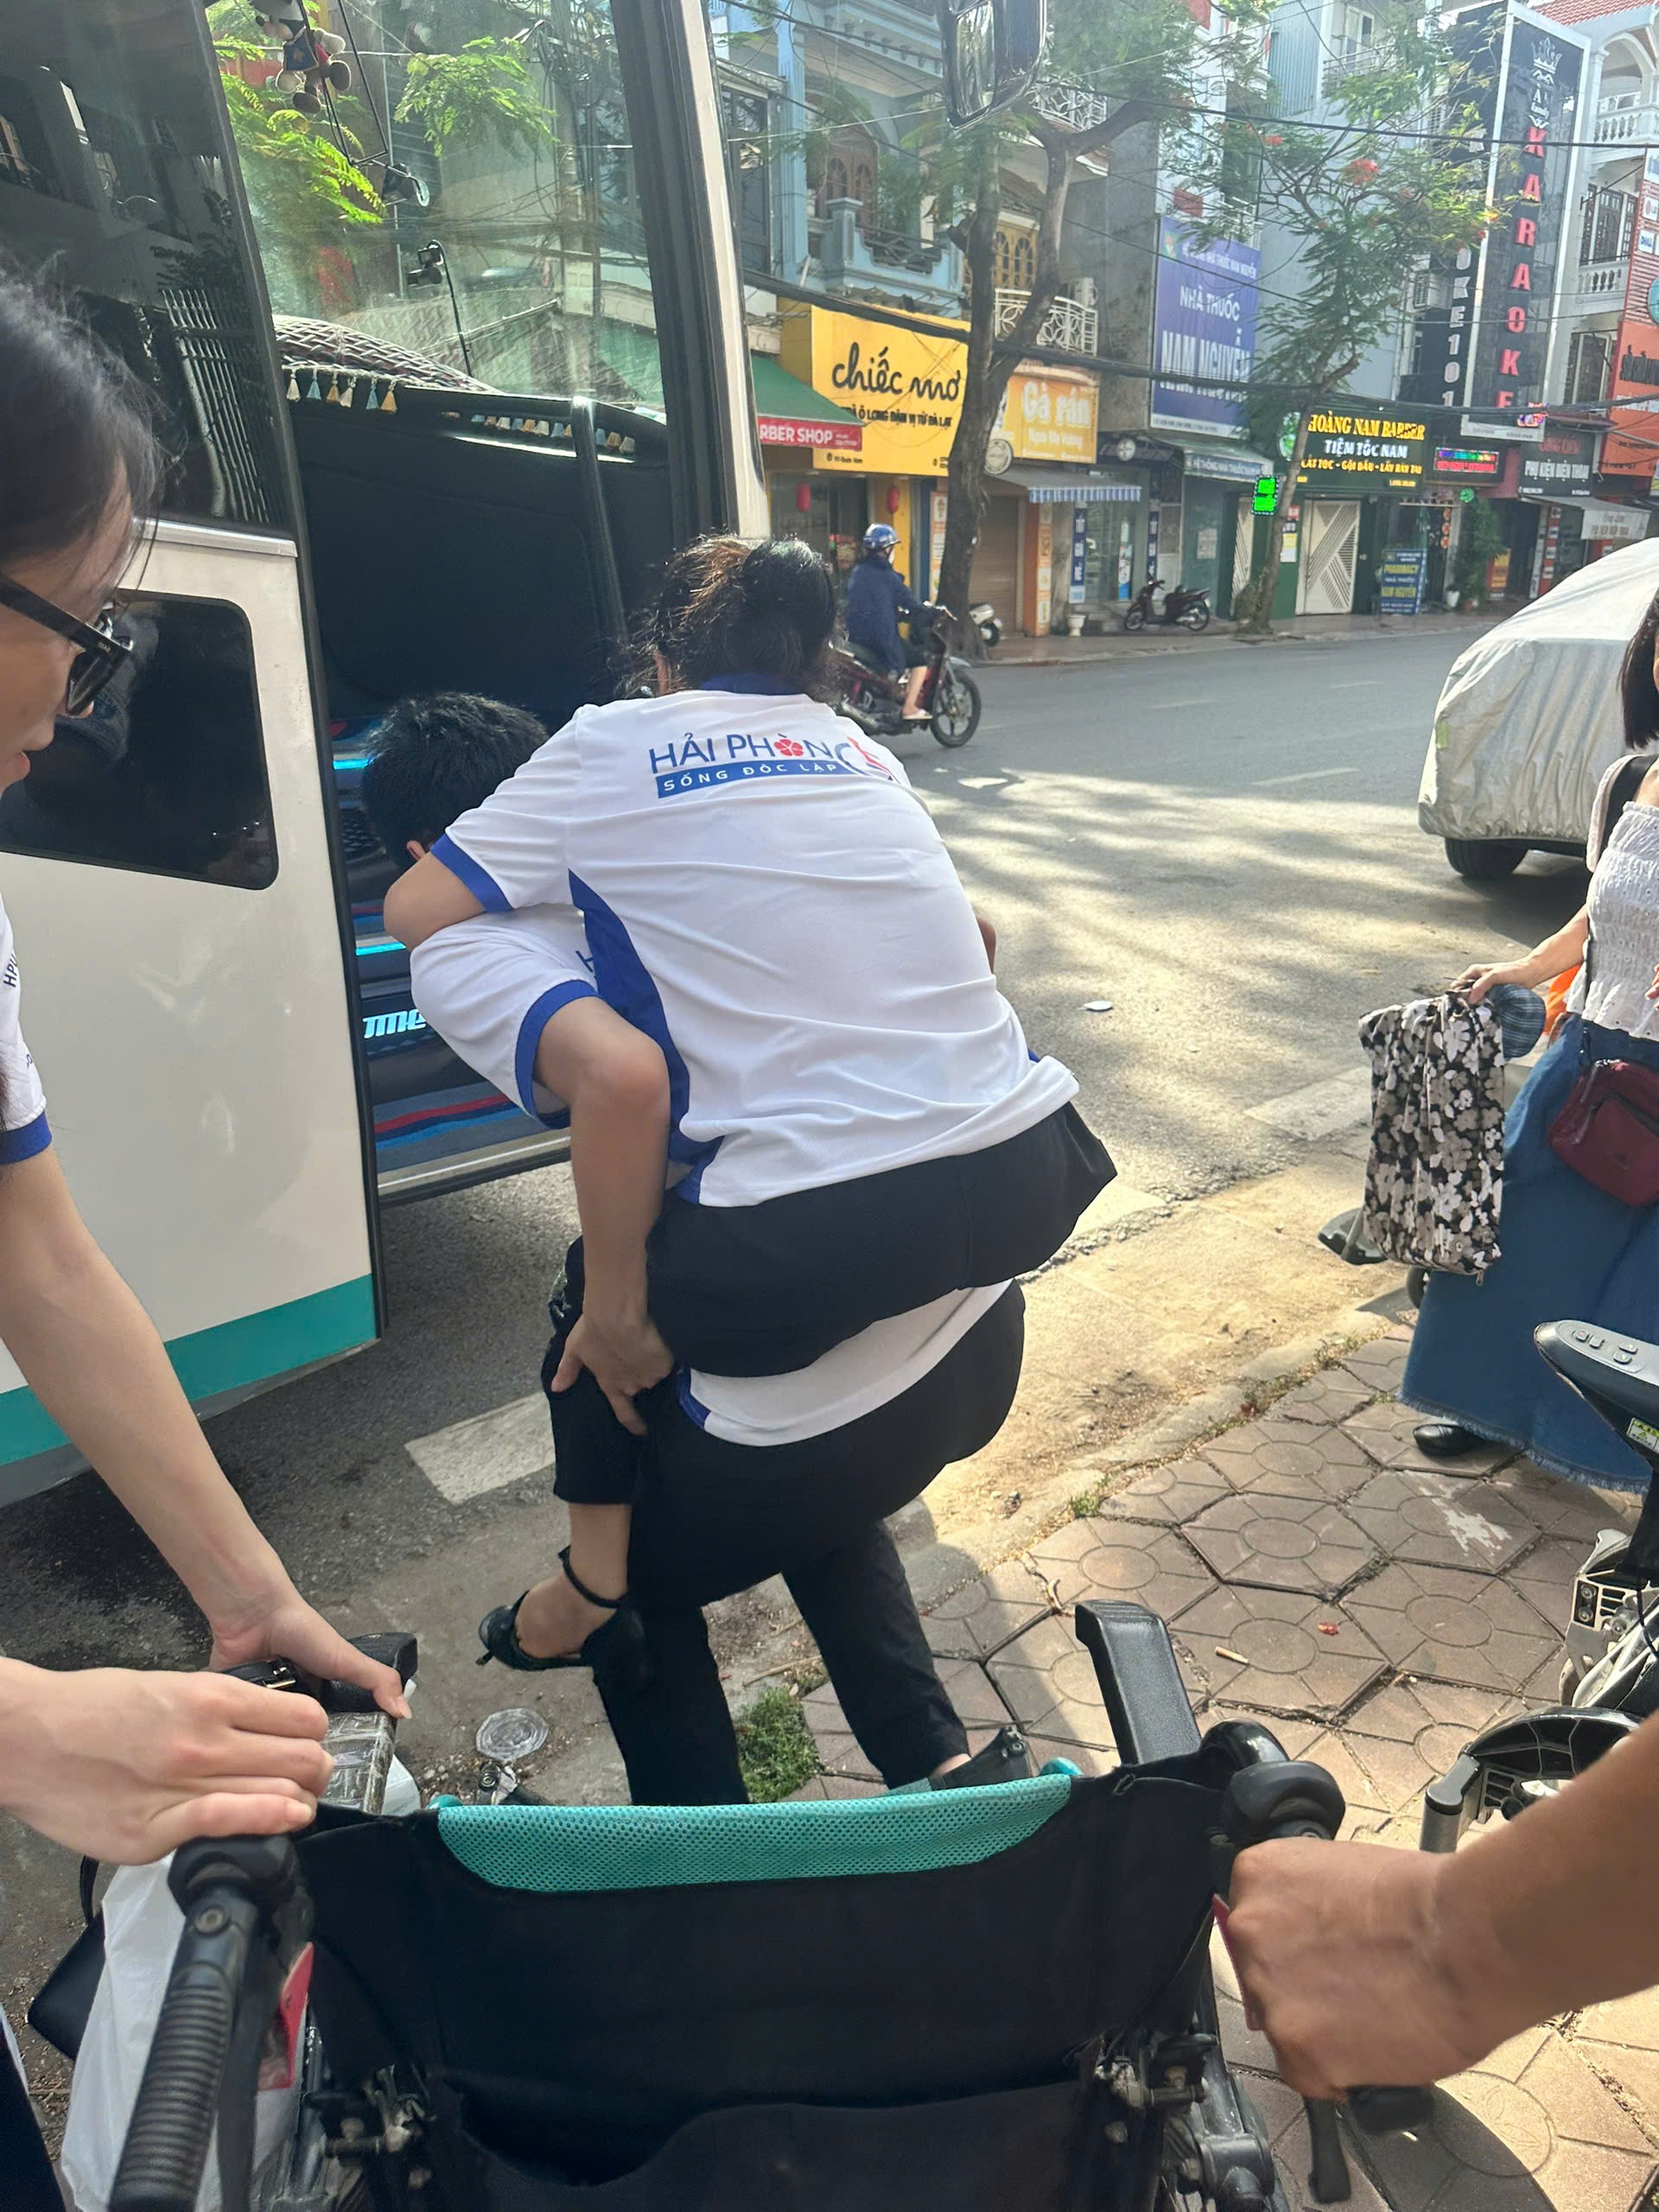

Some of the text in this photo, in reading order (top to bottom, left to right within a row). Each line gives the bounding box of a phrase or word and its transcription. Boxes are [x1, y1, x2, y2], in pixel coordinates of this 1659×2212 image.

[1496, 127, 1548, 410] KARAOKE
[1179, 284, 1240, 321] NHÀ THUỐC
[831, 341, 961, 402] chiếc mơ
[1022, 380, 1091, 429] Gà rán
[797, 428, 833, 444] SHOP
[1325, 436, 1355, 457] TIỆM
[1381, 443, 1408, 459] NAM
[1353, 418, 1381, 437] NAM
[1382, 420, 1426, 442] BARBER
[649, 732, 715, 773] HẢI
[663, 766, 728, 792] SỐNG
[799, 761, 837, 774] LẬP
